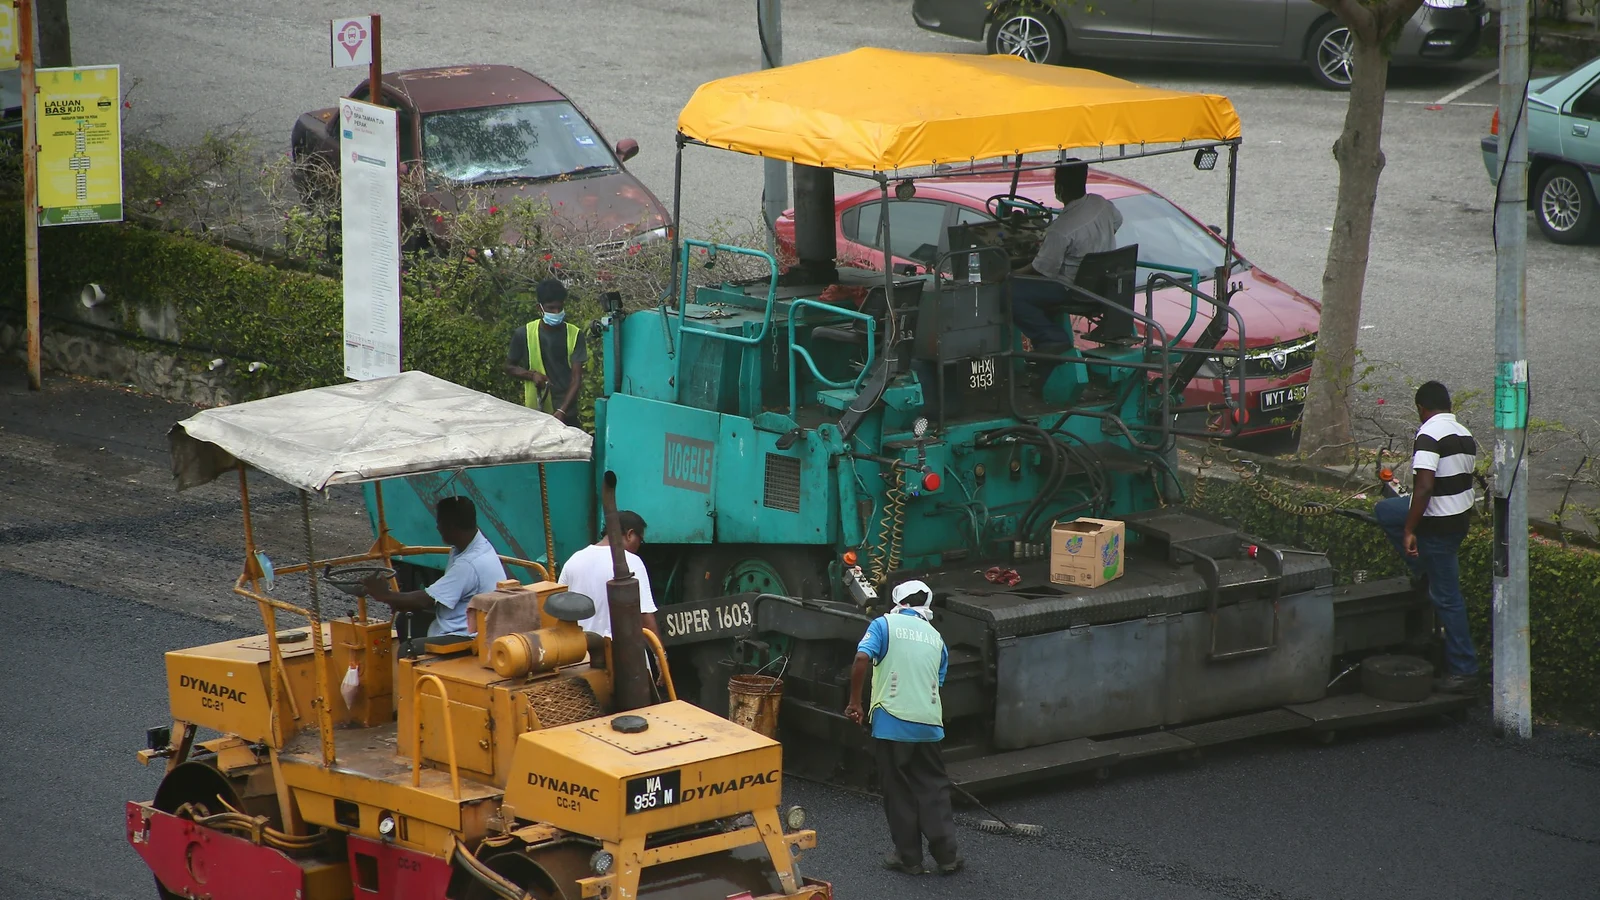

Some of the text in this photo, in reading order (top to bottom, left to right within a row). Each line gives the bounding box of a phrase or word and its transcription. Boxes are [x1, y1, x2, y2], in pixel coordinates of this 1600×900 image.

[44, 100, 81, 108] LALUAN
[45, 106, 66, 114] BAS
[971, 359, 991, 374] WHX
[969, 373, 993, 388] 3153
[1265, 390, 1285, 406] WYT
[667, 441, 711, 485] VOGELE
[666, 601, 752, 637] SUPER 1603
[180, 674, 247, 704] DYNAPAC
[201, 697, 225, 712] CC-21
[527, 772, 600, 802] DYNAPAC
[646, 776, 662, 794] WA
[681, 769, 779, 803] DYNAPAC
[556, 796, 581, 812] CC-21
[634, 789, 673, 810] 955 M
[398, 857, 421, 873] CC-21
